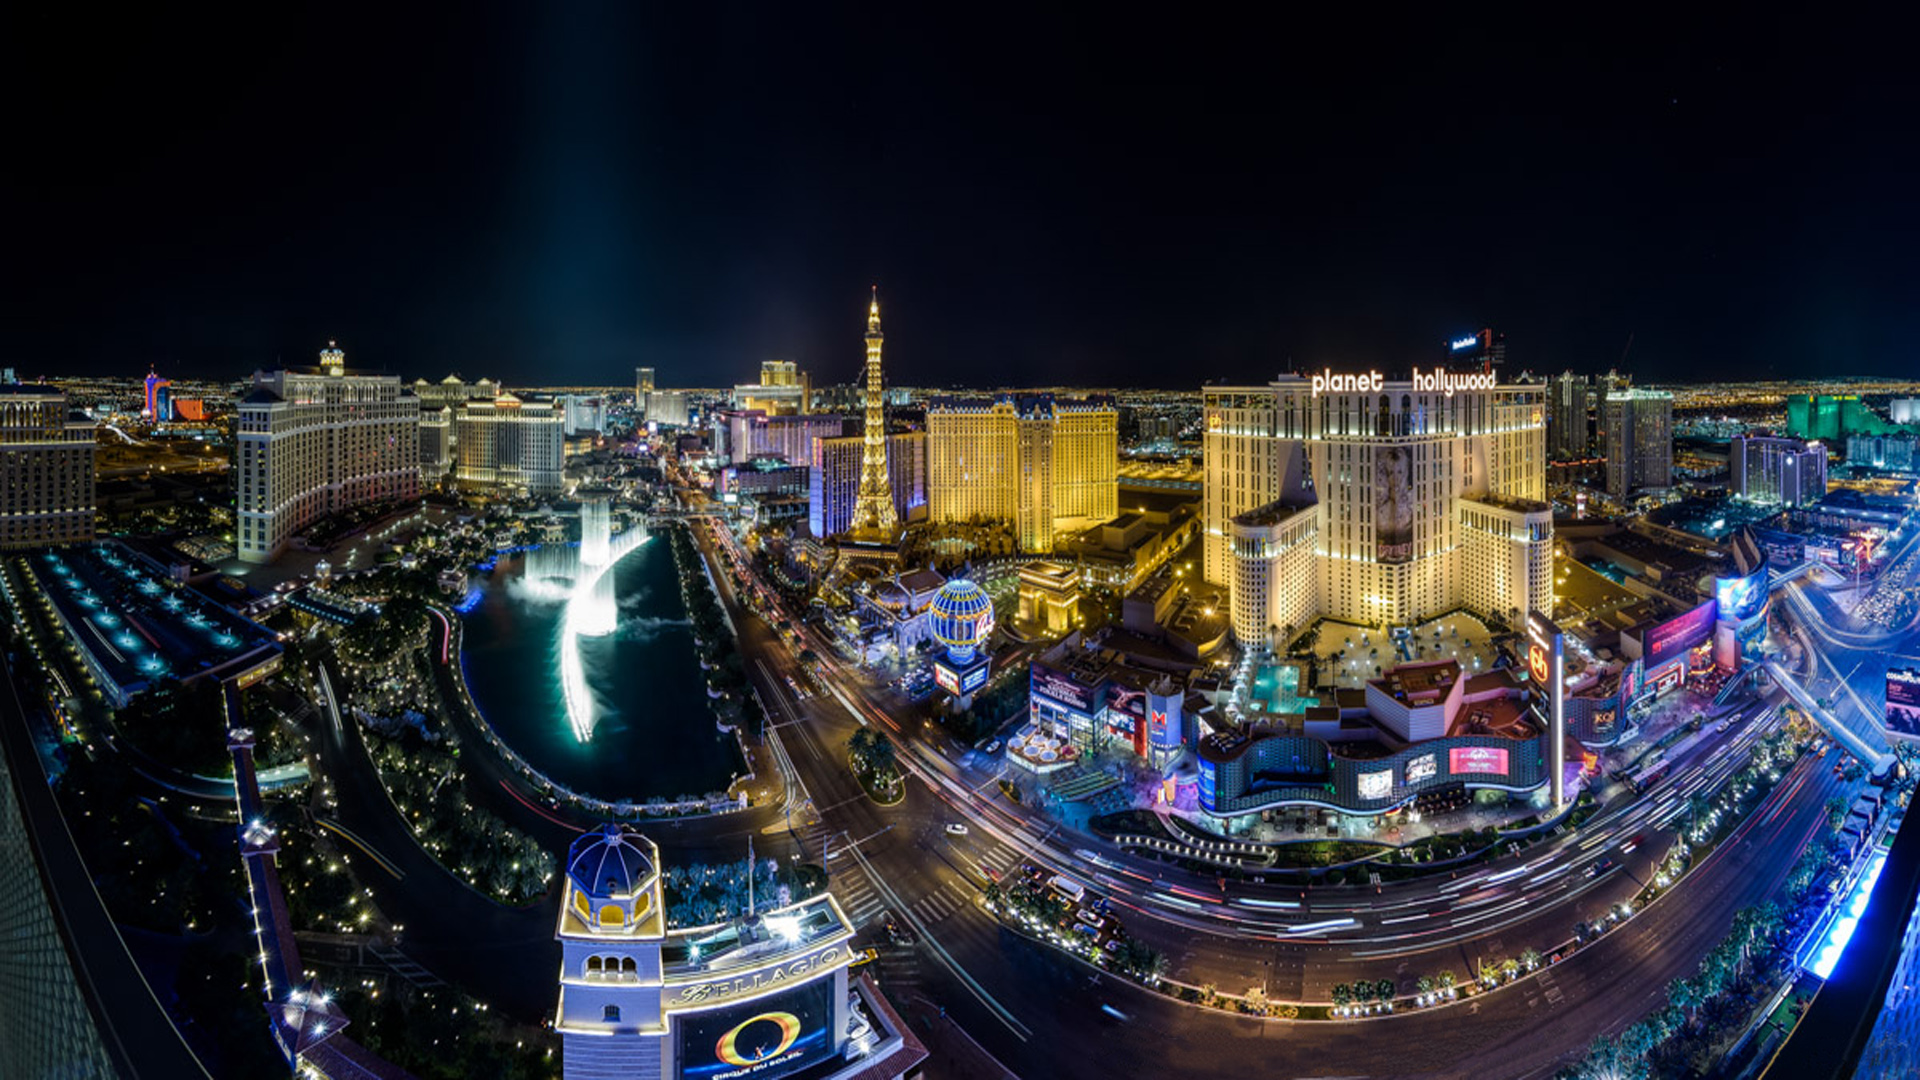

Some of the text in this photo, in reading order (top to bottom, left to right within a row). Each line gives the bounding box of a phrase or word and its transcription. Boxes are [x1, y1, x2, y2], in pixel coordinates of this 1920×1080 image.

[1311, 366, 1496, 398] planet hollywood
[672, 947, 839, 1003] BELLAGIO
[715, 1011, 801, 1066] O
[712, 1051, 803, 1080] CIRQUE DU SOLEIL
